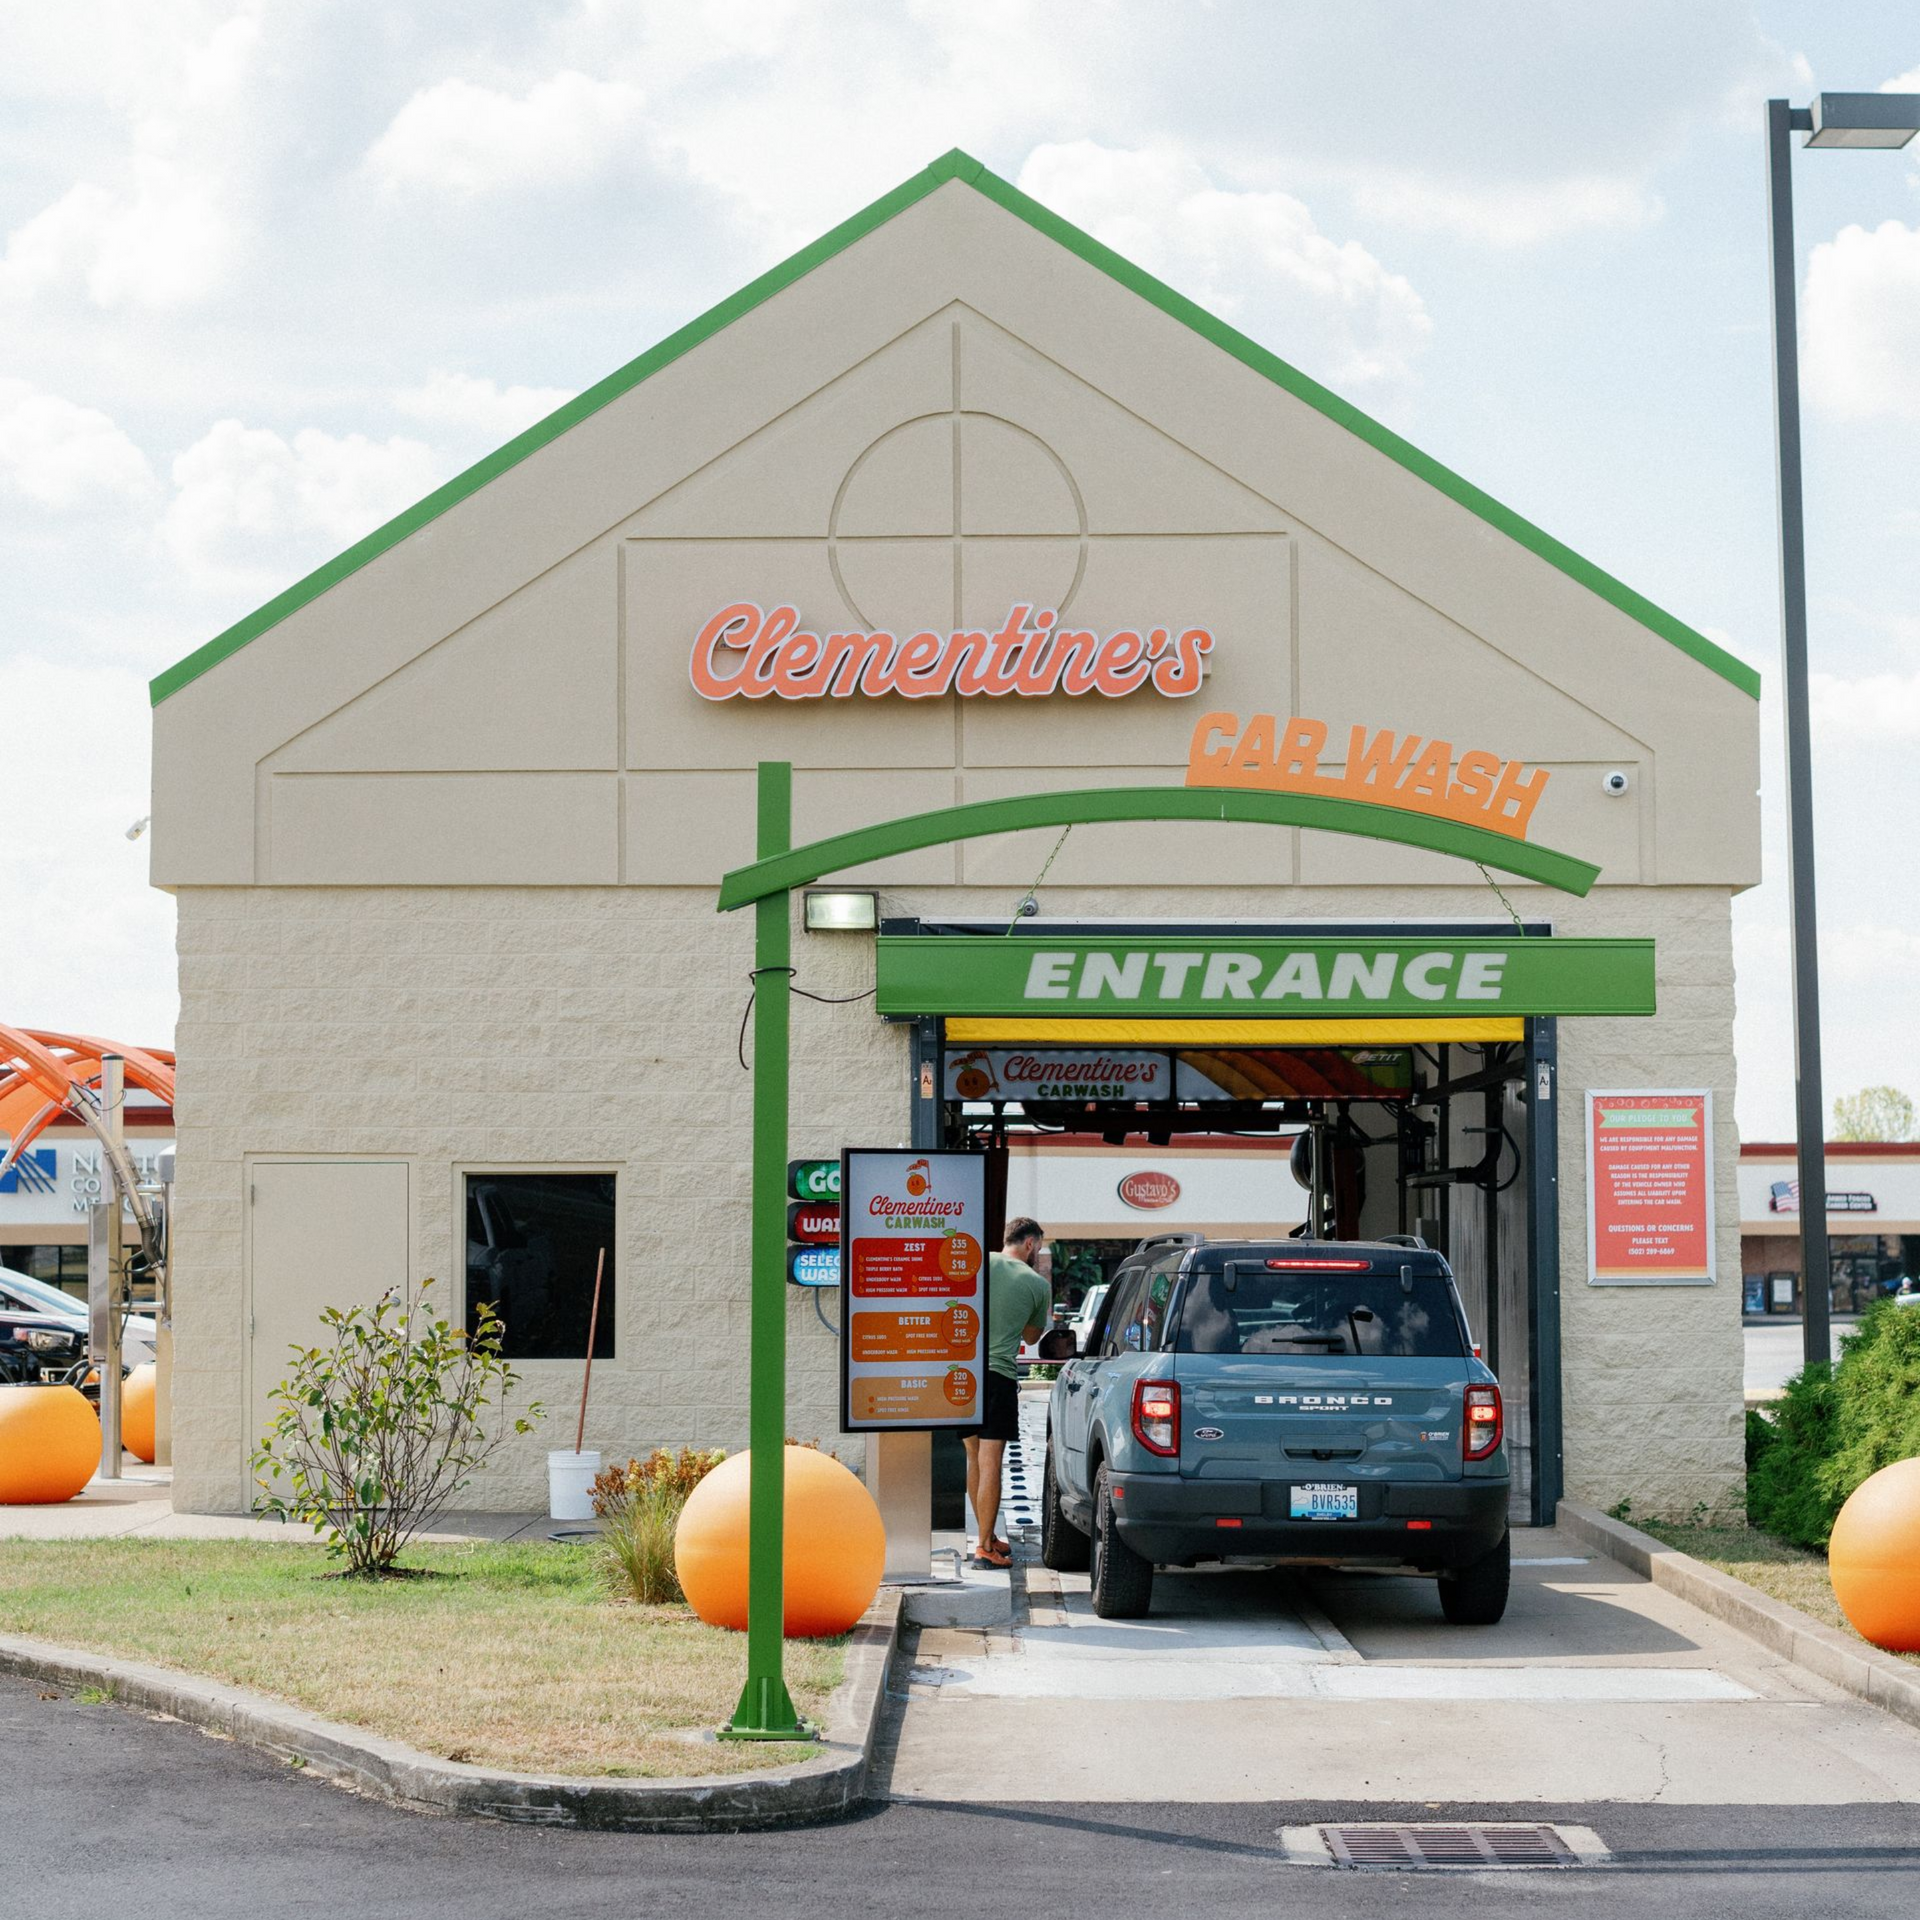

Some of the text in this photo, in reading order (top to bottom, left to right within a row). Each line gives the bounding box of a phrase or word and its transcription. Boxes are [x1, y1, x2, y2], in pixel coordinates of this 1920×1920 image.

[688, 601, 1215, 702] Clementine's
[1186, 711, 1551, 840] CAR WASH
[1023, 951, 1509, 1001] ENTRANCE
[1003, 1055, 1158, 1083] Clementine's
[1037, 1084, 1124, 1097] CARWASH
[808, 1170, 840, 1192] GO
[1126, 1180, 1176, 1196] Gustavo's
[869, 1195, 964, 1216] Clementine's
[803, 1218, 840, 1232] WAI
[884, 1216, 945, 1229] CARWASH
[1608, 1224, 1694, 1232] QUESTIONS OR CONCERNS
[904, 1243, 926, 1252] ZEST
[952, 1238, 967, 1250] $35
[800, 1255, 840, 1267] SELEC
[952, 1259, 966, 1270] $18
[802, 1268, 840, 1281] WAS
[953, 1309, 968, 1320] $30
[898, 1316, 931, 1326] BETTER
[954, 1328, 967, 1337] $15
[954, 1372, 968, 1380] $20
[900, 1380, 928, 1388] BASIC
[1254, 1396, 1392, 1406] BRONCO
[1200, 1429, 1217, 1438] Ford
[1312, 1494, 1356, 1510] BVR535
